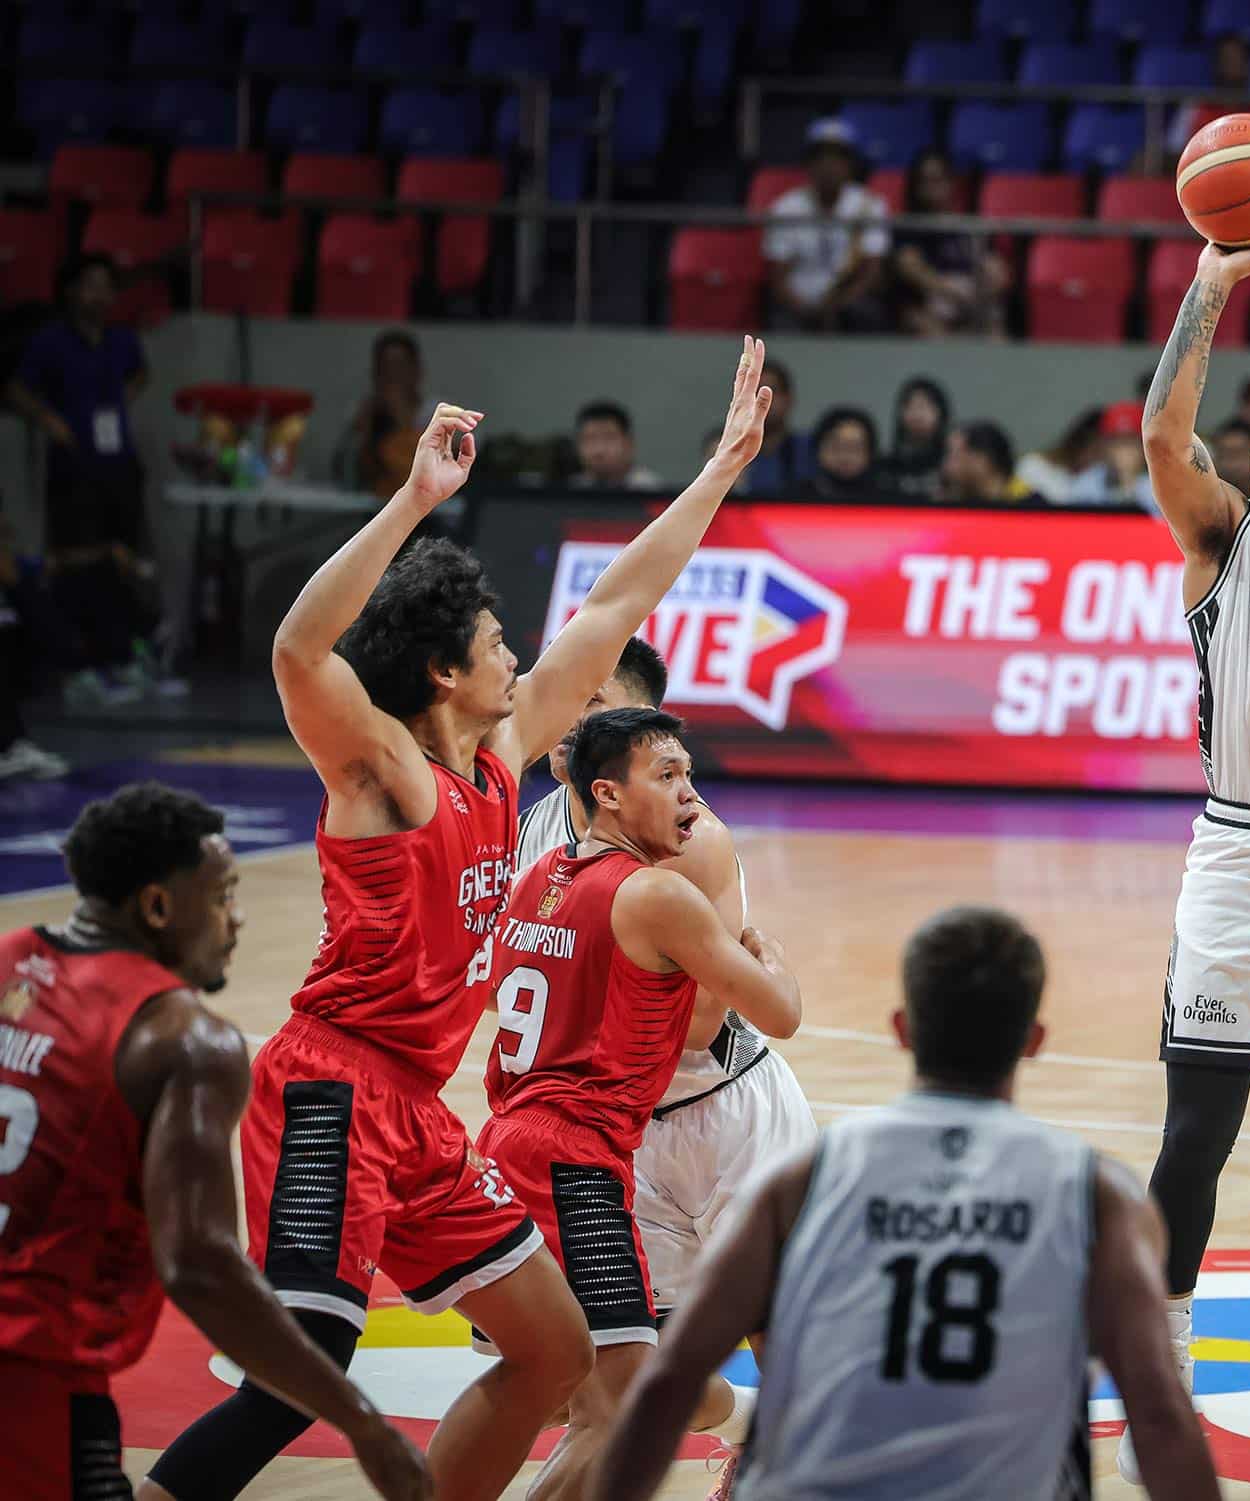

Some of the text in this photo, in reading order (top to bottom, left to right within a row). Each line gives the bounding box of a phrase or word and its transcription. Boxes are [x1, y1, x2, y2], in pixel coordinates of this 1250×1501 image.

[900, 554, 1050, 640] THE
[992, 653, 1199, 739] SPOR
[501, 917, 577, 960] THOMPSON
[497, 966, 549, 1075] 9
[1183, 1005, 1237, 1024] Organics
[1195, 994, 1224, 1010] Ever
[865, 1196, 1032, 1244] ROSARIO
[880, 1253, 1002, 1384] 18
